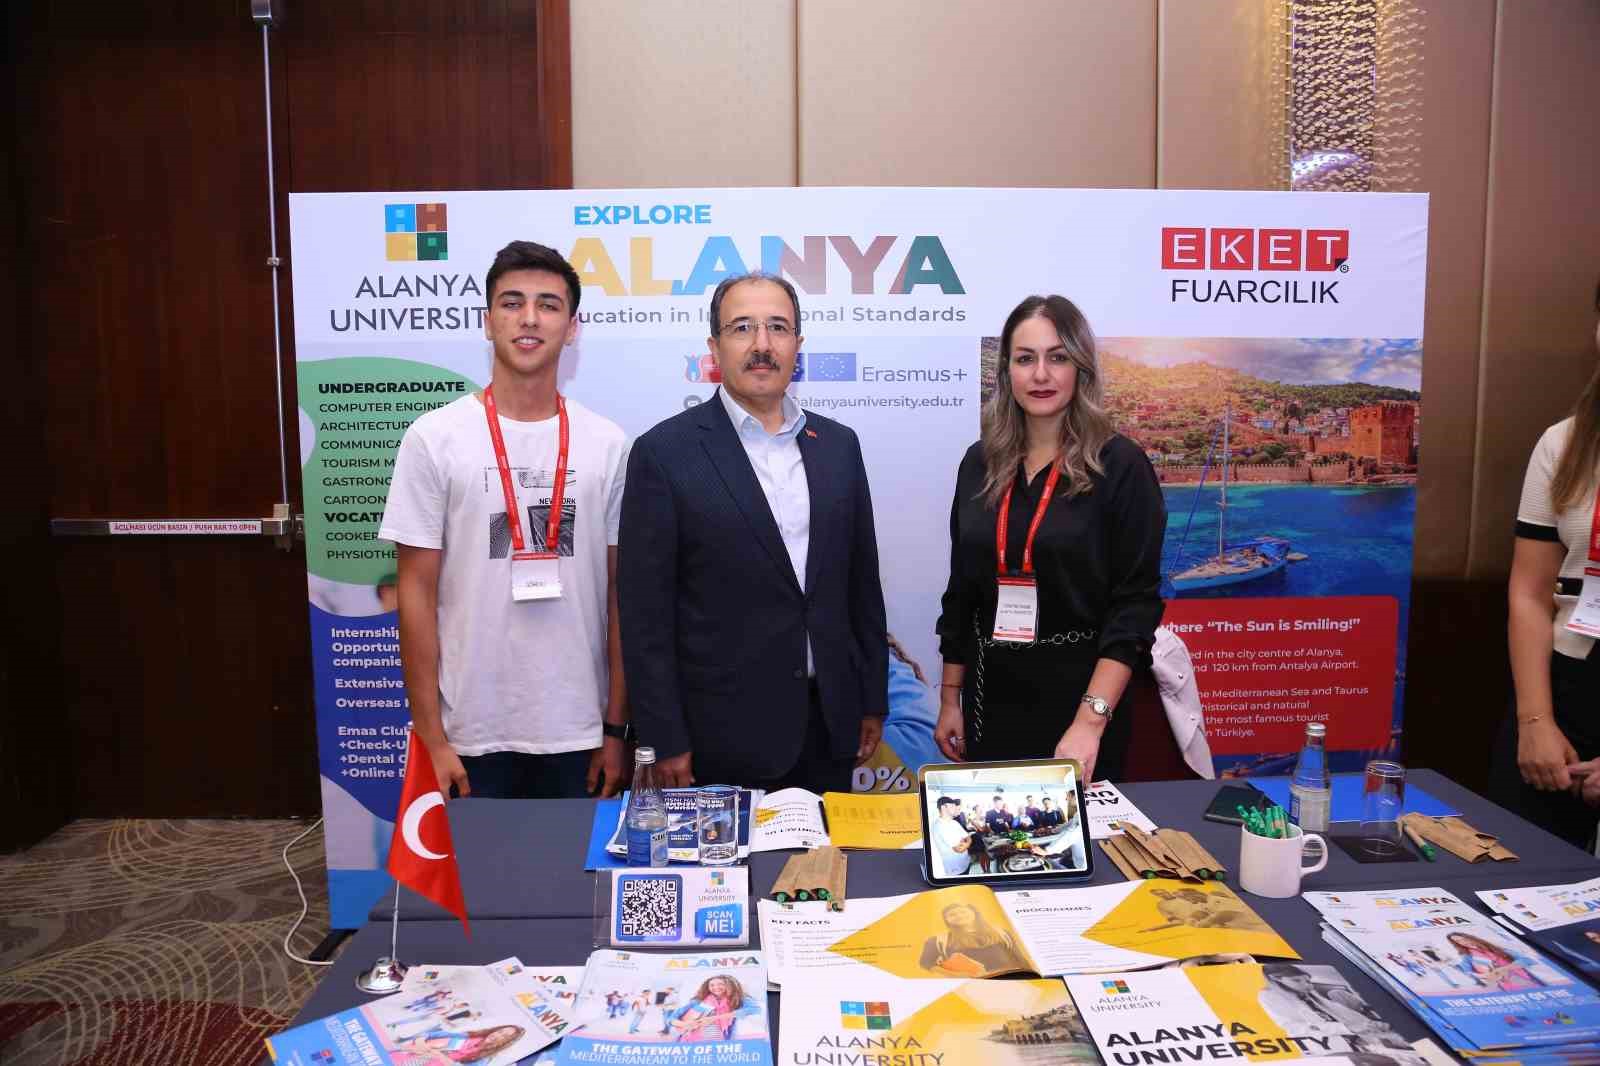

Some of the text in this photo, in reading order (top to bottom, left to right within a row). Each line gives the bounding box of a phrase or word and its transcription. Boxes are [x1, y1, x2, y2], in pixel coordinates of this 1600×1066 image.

[573, 204, 712, 225] EXPLORE
[1172, 233, 1343, 266] EKET
[568, 235, 967, 297] ALANYA
[356, 274, 482, 299] ALANYA
[1171, 279, 1340, 304] FUARCILIK
[330, 306, 488, 331] UNIVERSIT
[577, 307, 662, 324] ucation
[670, 306, 690, 323] in
[852, 306, 966, 323] Standards
[862, 366, 968, 383] Erasmus+
[318, 381, 465, 394] UNDERGRADUATE
[319, 401, 450, 413] COMPUTER ENGINE
[320, 421, 413, 431] ARCHITECTUR
[321, 439, 402, 450] COMMUNICA
[321, 458, 380, 468] TOURISM
[323, 495, 387, 505] CARTOON
[561, 497, 576, 505] ORK
[325, 532, 379, 542] COOKER
[327, 550, 400, 560] PHYSIOTHE
[1246, 620, 1275, 633] Sun
[1279, 618, 1291, 632] is
[332, 642, 401, 655] Opportun
[1204, 650, 1214, 659] in
[1217, 649, 1235, 659] the
[1237, 647, 1256, 660] city
[1258, 649, 1291, 659] centre
[1294, 647, 1305, 658] of
[333, 655, 402, 668] companie
[1213, 663, 1230, 672] 120
[1232, 662, 1249, 672] km
[1251, 661, 1277, 672] from
[1279, 660, 1319, 673] Antalya
[335, 677, 404, 689] Extensive
[1212, 687, 1288, 699] Mediterranean
[1290, 686, 1310, 697] Sea
[1312, 686, 1332, 697] and
[1334, 685, 1369, 696] Taurus
[335, 697, 402, 709] Overseas
[1201, 700, 1310, 712] historical and natural
[1205, 711, 1330, 725] the most famous tourist
[337, 726, 377, 736] Emaa
[338, 739, 406, 750] +Check-U
[340, 753, 394, 764] +Dental
[341, 767, 395, 778] +Online
[705, 910, 733, 919] SCAN
[705, 919, 734, 933] ME!
[665, 955, 760, 969] ALANYA
[1089, 999, 1162, 1013] UNIVERSITY
[1098, 994, 1149, 1005] ALANYA
[1106, 1022, 1257, 1048] ALANYA
[816, 1035, 922, 1049] ALANYA
[592, 1043, 744, 1055] THE GATEWAY OF THE
[1112, 1035, 1332, 1066] UNIVERSITY
[569, 1049, 760, 1066] MEDITERRANEAN TO THE WORLD
[793, 1052, 945, 1066] UNIVERSITY
